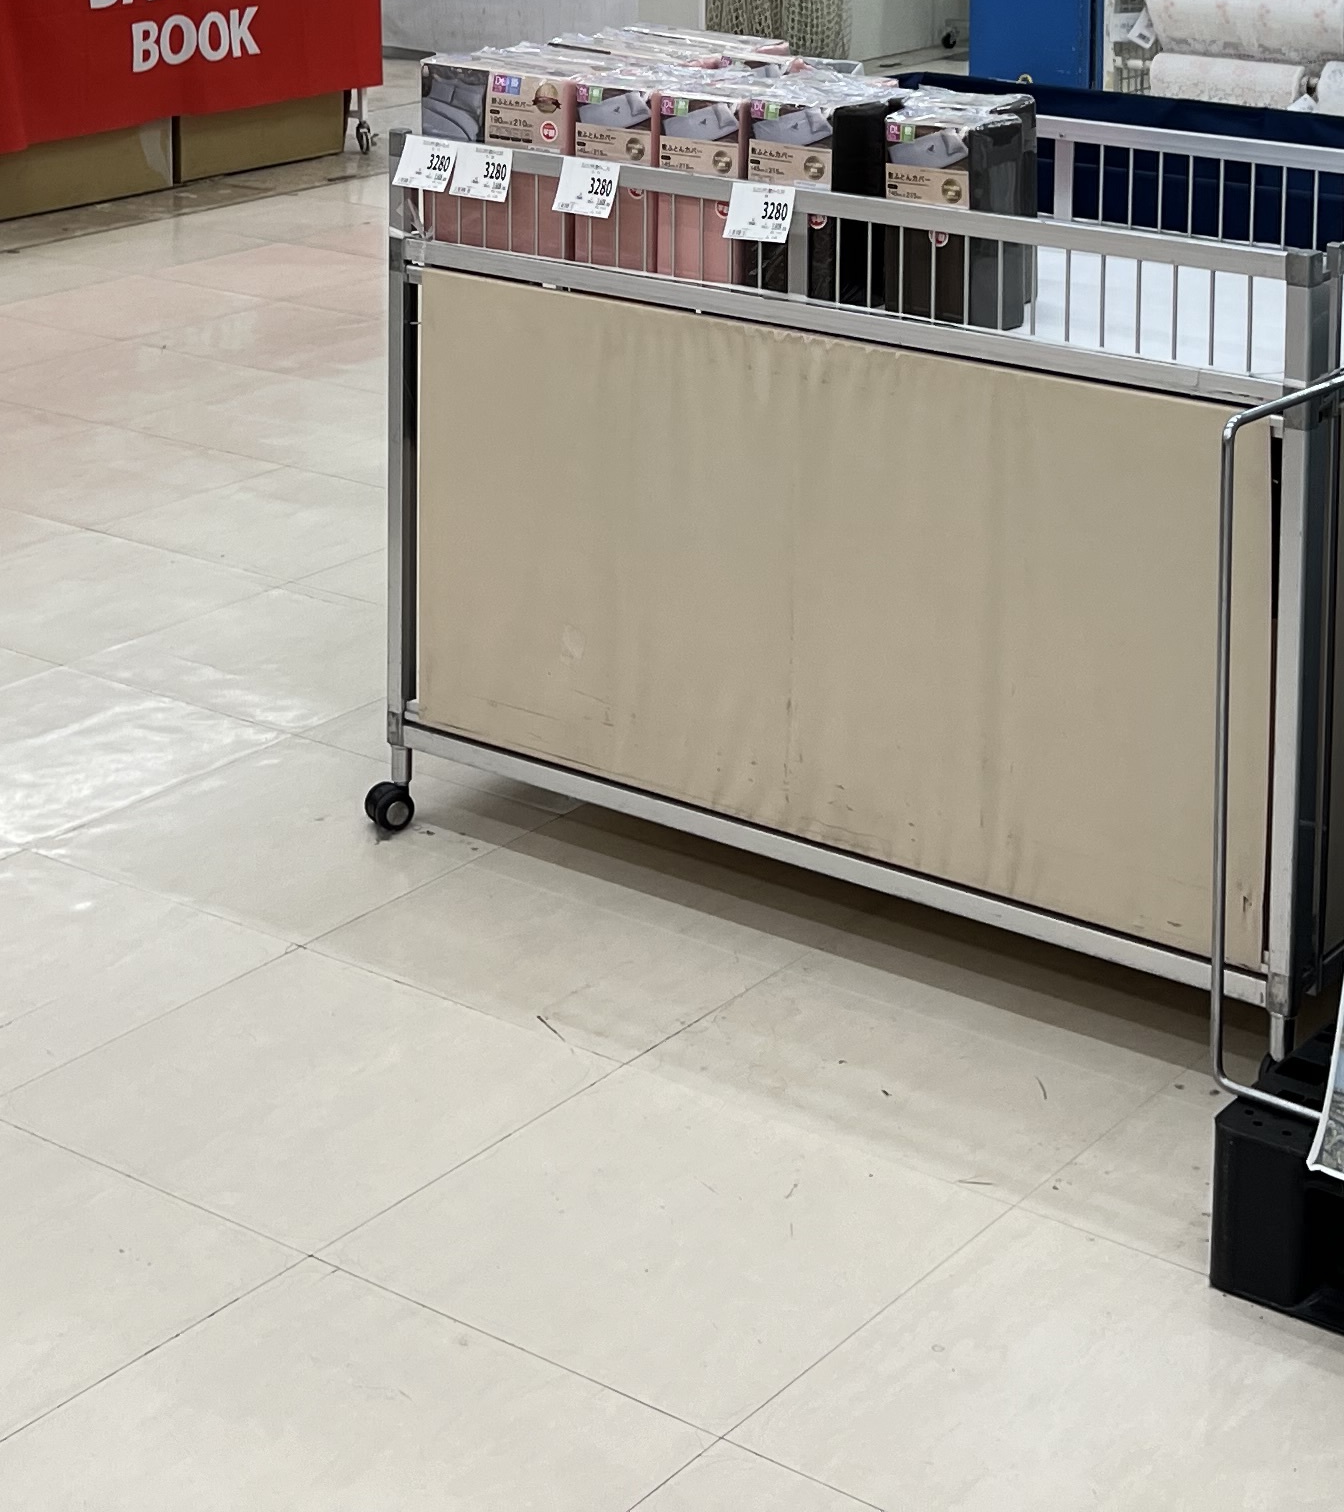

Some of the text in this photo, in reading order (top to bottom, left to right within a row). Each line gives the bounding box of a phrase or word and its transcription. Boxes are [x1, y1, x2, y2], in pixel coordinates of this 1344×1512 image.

[131, 5, 261, 74] BOOK
[427, 153, 451, 173] 3280
[483, 161, 507, 181] 3280
[588, 177, 613, 197] 3280
[761, 201, 788, 221] 3280
